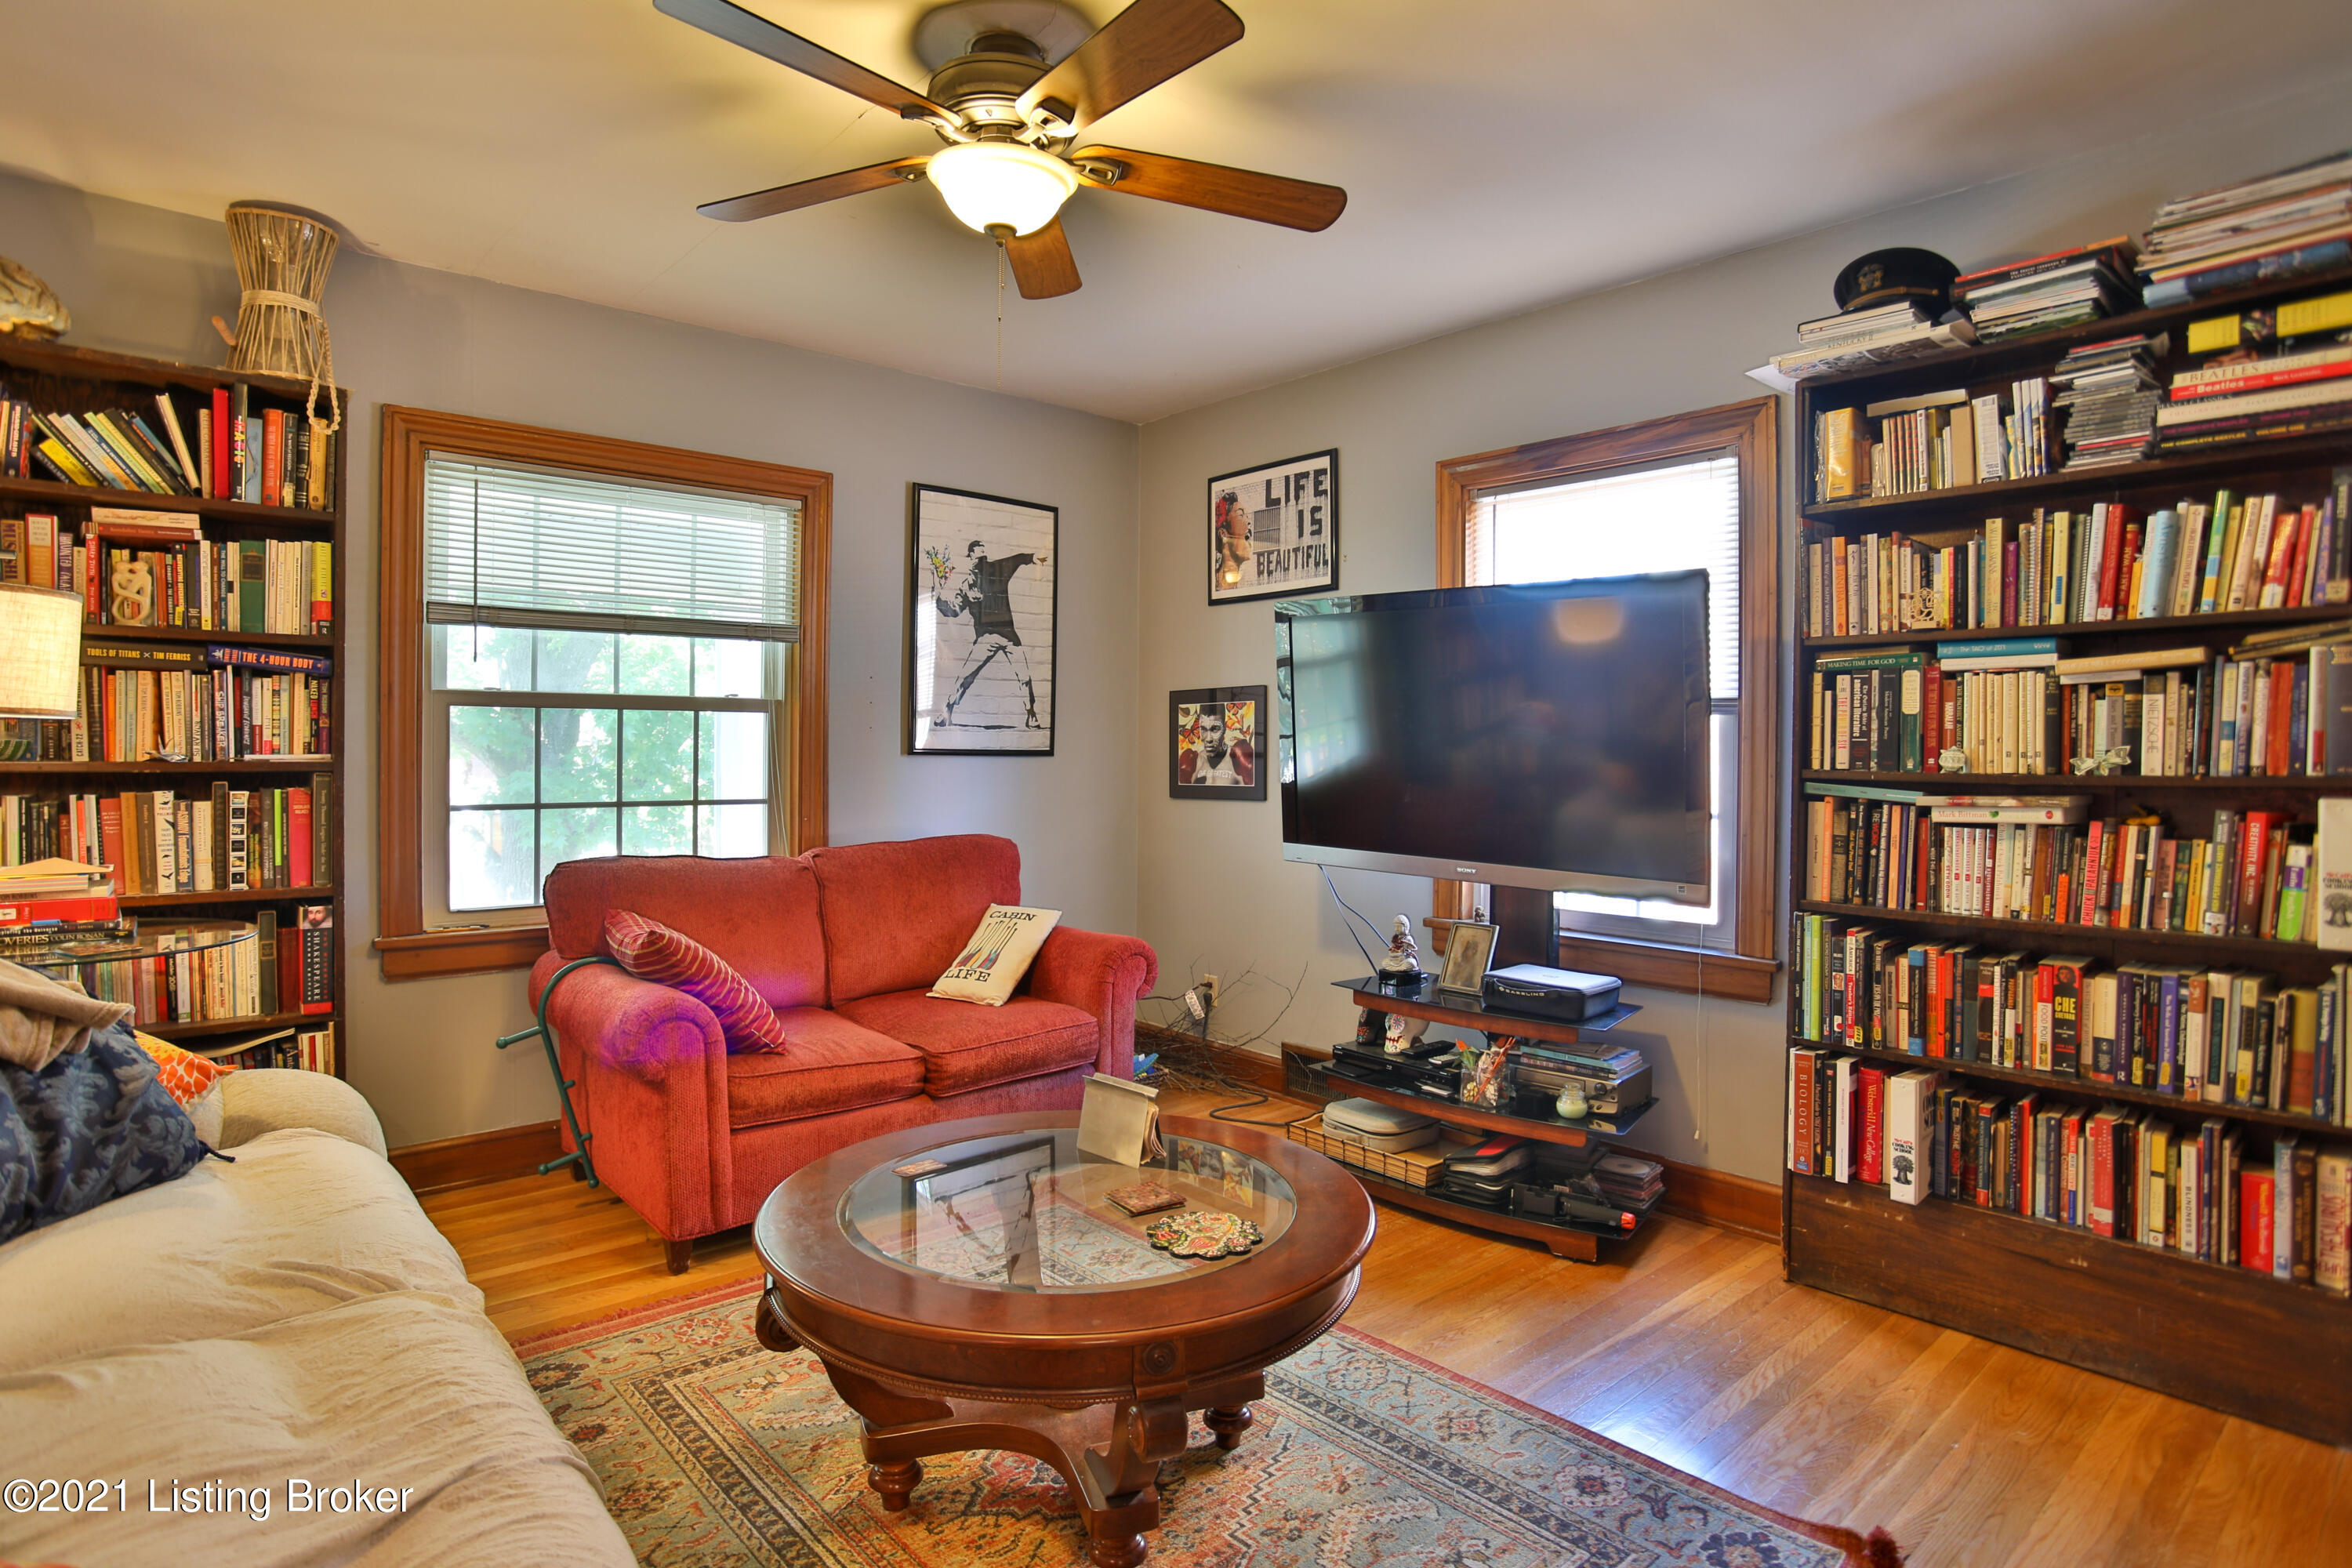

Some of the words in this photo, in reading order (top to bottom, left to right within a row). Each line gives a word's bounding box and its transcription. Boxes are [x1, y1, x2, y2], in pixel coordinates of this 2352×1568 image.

[1828, 337, 1865, 348] KENTUCKY
[2190, 365, 2259, 383] BEATLES
[2197, 379, 2245, 393] Beatles
[234, 420, 245, 463] MAGIC
[2215, 433, 2246, 441] BEATLES
[2256, 427, 2287, 436] VOLUME
[1265, 468, 1328, 507] LIFE
[1298, 506, 1323, 539] IS
[1988, 527, 1998, 549] WILD
[3, 524, 17, 579] MUSSHI
[60, 537, 72, 566] HAUNTED
[1253, 543, 1328, 576] BEAUTIFUL
[1988, 552, 1998, 575] SWANS
[88, 648, 106, 657] TOOLS
[119, 649, 140, 659] TITANS
[154, 652, 163, 660] TIM
[166, 652, 191, 661] FERRISS
[242, 652, 257, 662] THE
[260, 652, 289, 667] 4-HOUR
[292, 656, 314, 669] BODY
[1838, 698, 1847, 707] THE
[1838, 710, 1847, 728] POWER
[1853, 709, 1861, 737] literature
[1944, 702, 1954, 728] KABBALAH
[2147, 699, 2158, 753] NIETZSCHE
[217, 711, 226, 746] BREAKER
[1838, 740, 1846, 749] SIX
[177, 811, 189, 833] ASIMOV
[1871, 813, 1880, 846] REWORK
[179, 836, 189, 868] Foundation's
[2246, 822, 2260, 862] CREATIVITY,
[178, 869, 189, 883] Edge
[2085, 846, 2098, 890] PALAHNIUK
[2245, 865, 2256, 878] INC.
[2289, 868, 2299, 887] Latin
[989, 911, 1036, 921] CABIN
[2082, 895, 2095, 921] CHUCK
[2287, 892, 2296, 919] English
[944, 969, 991, 982] LIFE
[1927, 950, 1936, 993] FREAKONOMICS
[2041, 1004, 2051, 1024] FOOD
[2055, 996, 2076, 1012] CHE
[1798, 1074, 1808, 1135] BIOLOGY
[1867, 1084, 1877, 1116] Webster's
[1864, 1139, 1874, 1163] College
[1952, 1138, 1959, 1149] ME
